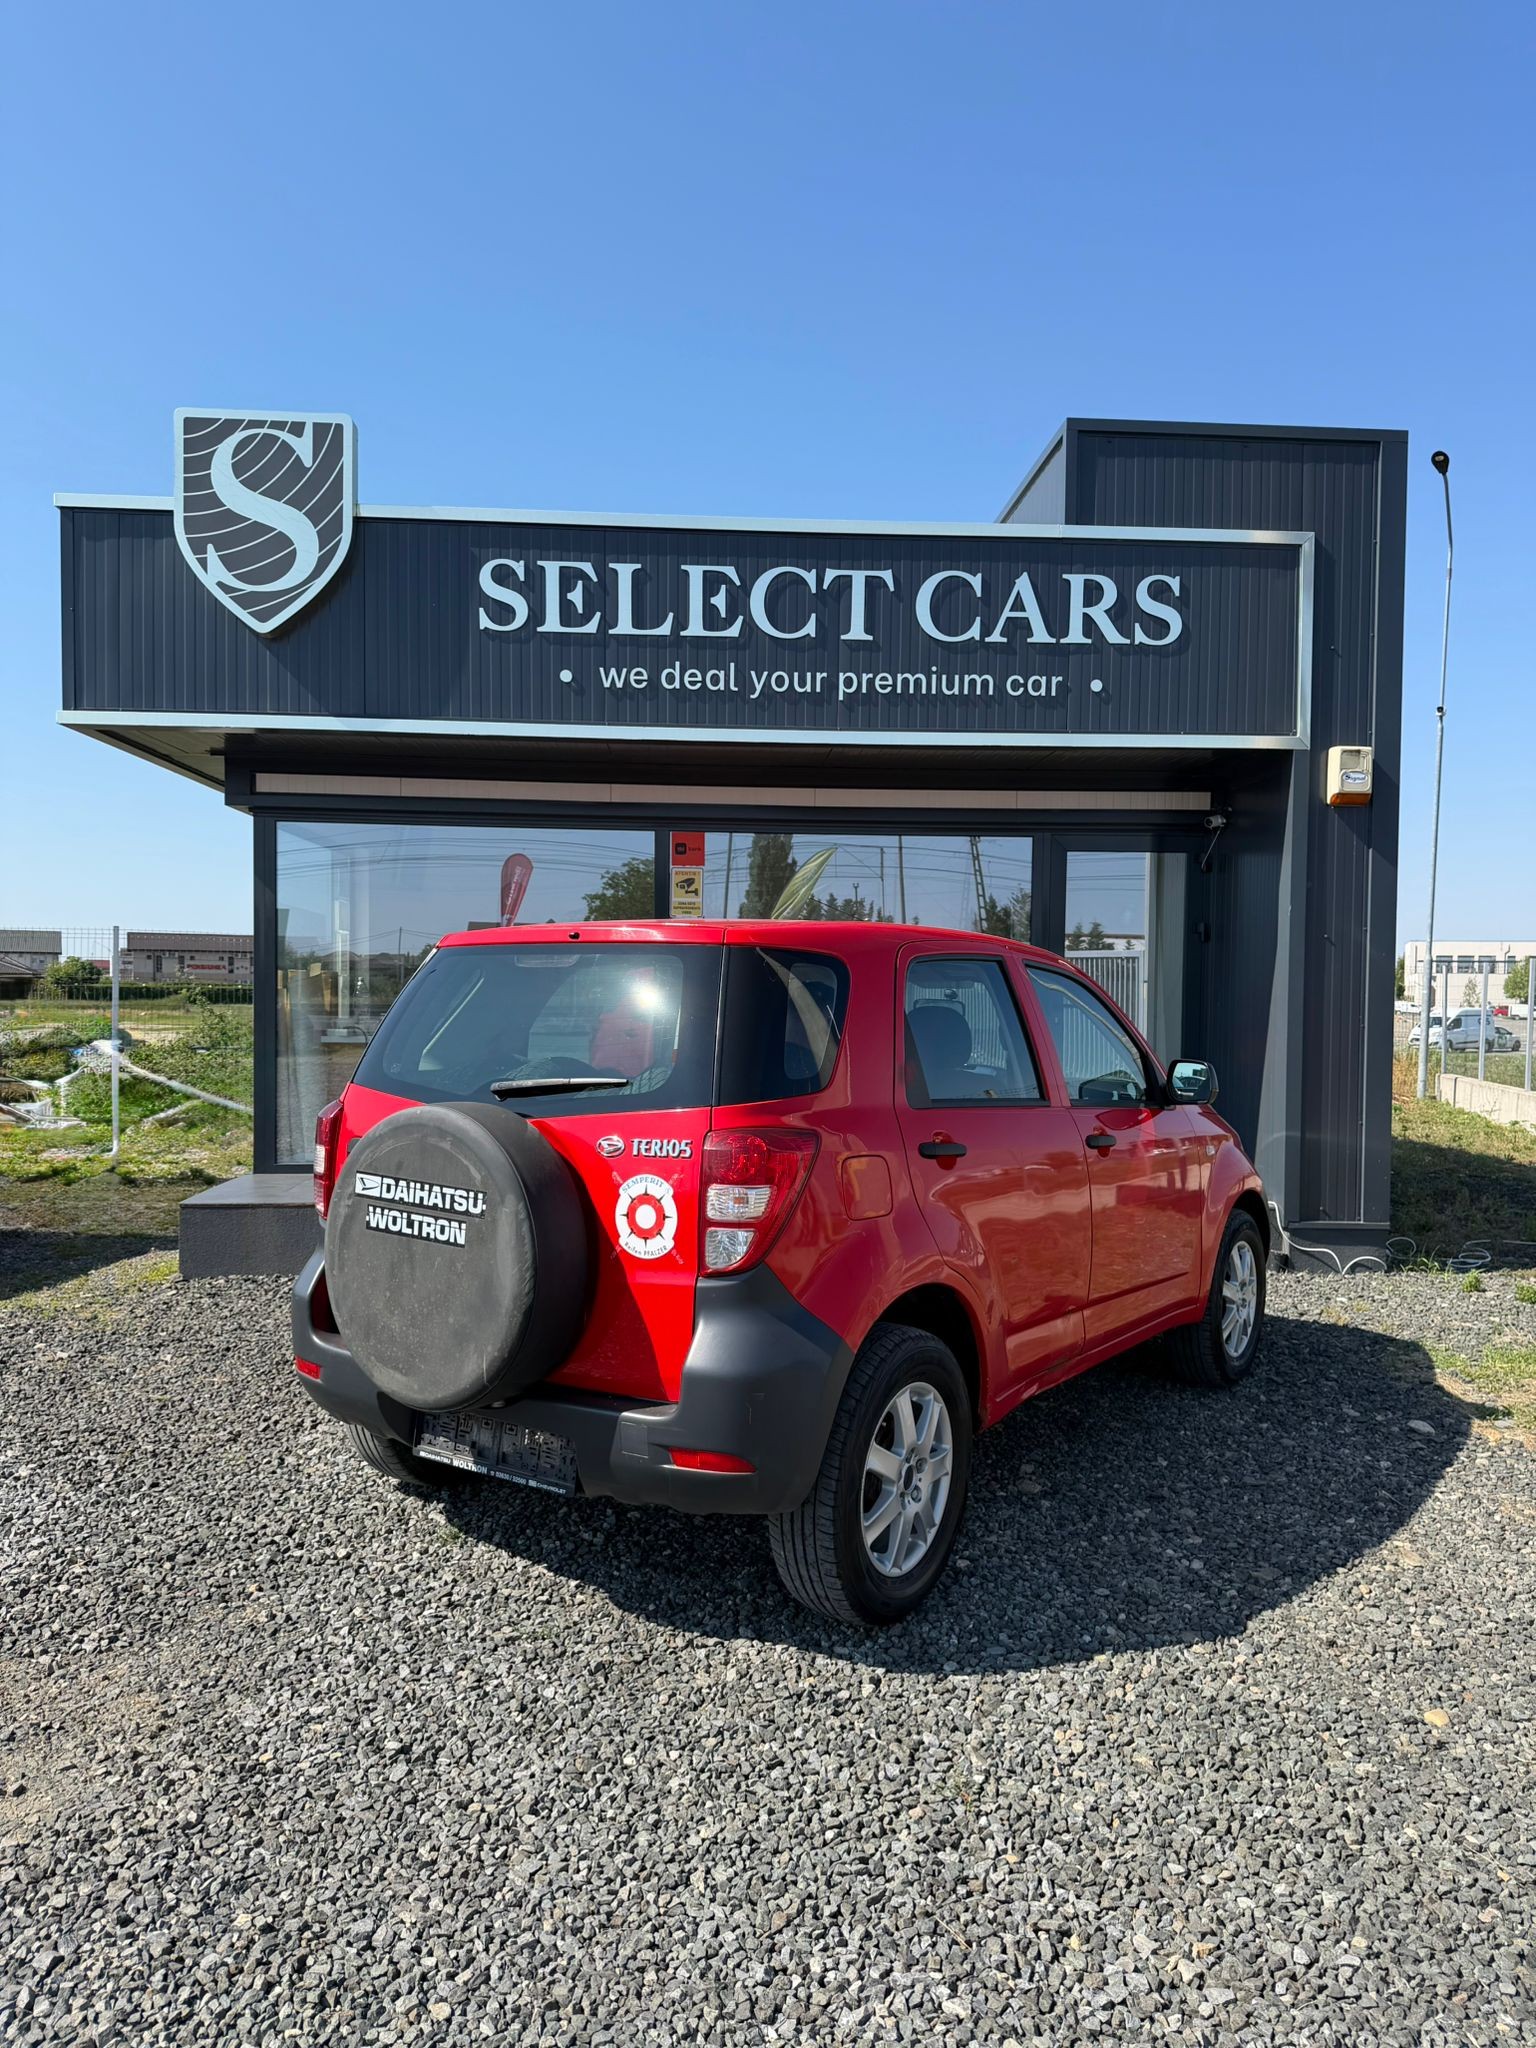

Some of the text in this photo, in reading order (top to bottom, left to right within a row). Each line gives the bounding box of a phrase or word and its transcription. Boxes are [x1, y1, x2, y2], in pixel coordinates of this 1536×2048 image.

[207, 420, 319, 592] S
[479, 558, 1183, 646] SELECT CARS
[599, 661, 1063, 701] we deal your premium car
[632, 1138, 692, 1158] TERIOS
[621, 1176, 664, 1194] SEMPERIT
[452, 1458, 488, 1475] WOLTRON
